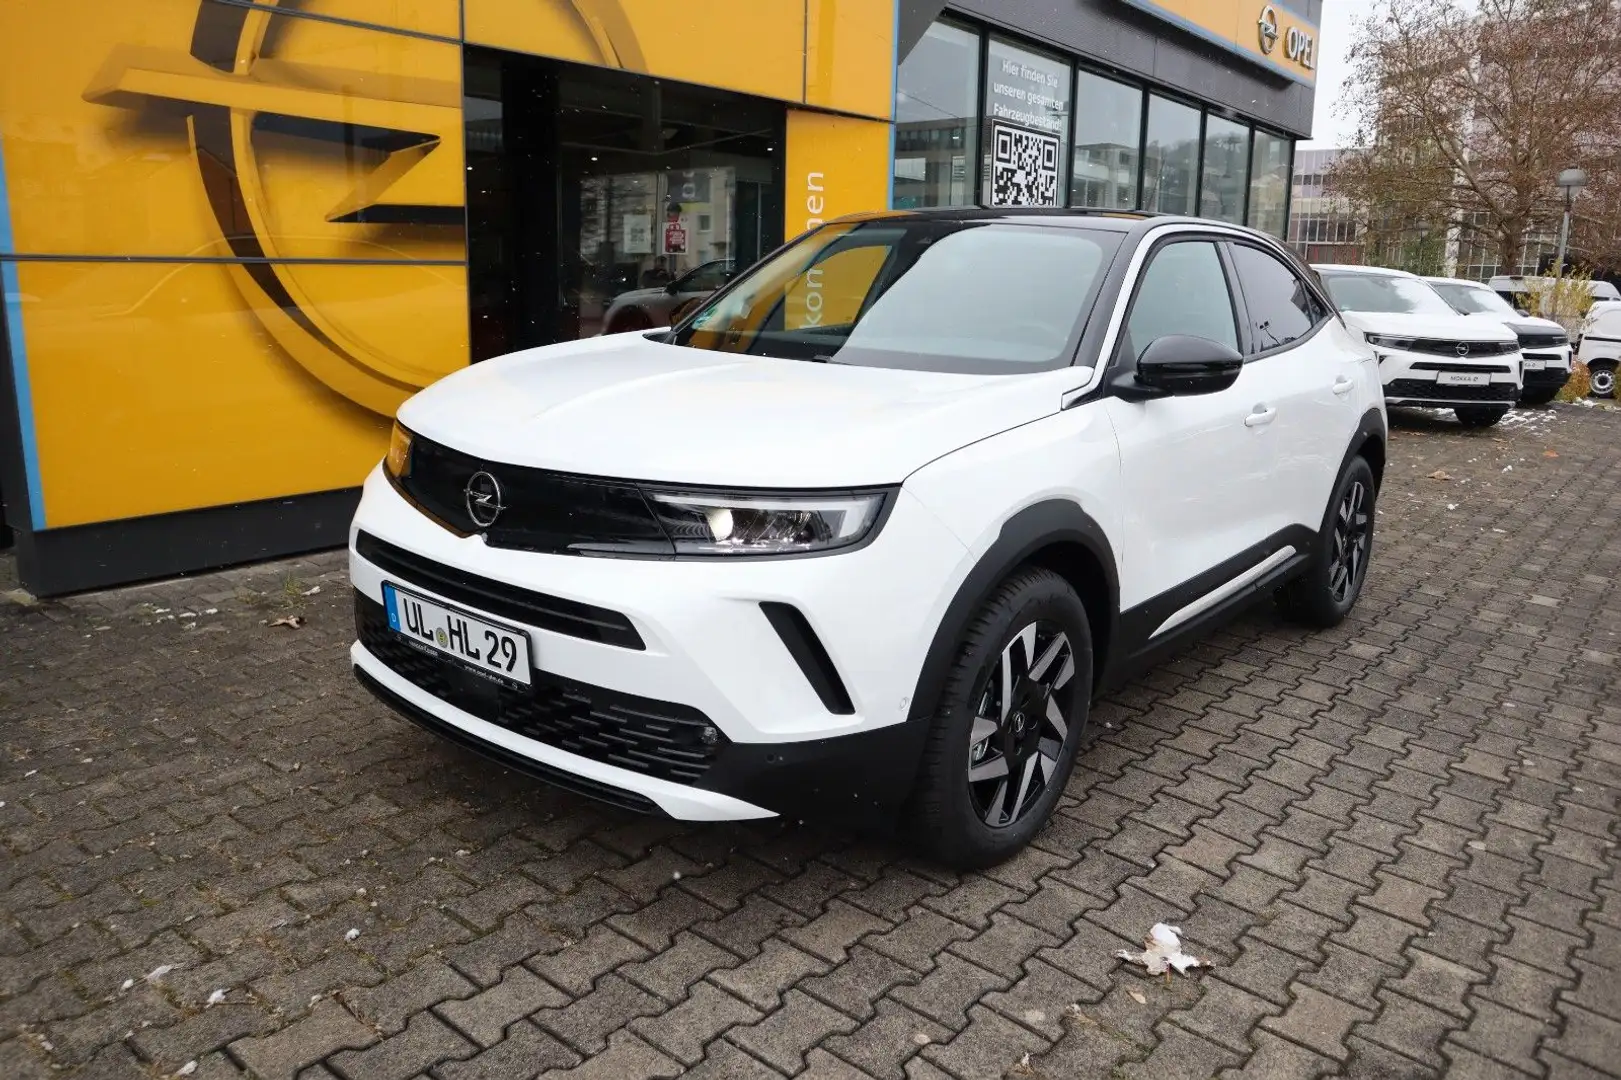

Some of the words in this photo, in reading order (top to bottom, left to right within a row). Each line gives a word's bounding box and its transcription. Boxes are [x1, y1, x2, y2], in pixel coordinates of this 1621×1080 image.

[1285, 27, 1315, 69] OPEL
[1002, 59, 1018, 77] Hier
[1020, 64, 1045, 84] finden
[1047, 74, 1058, 88] Sie
[993, 82, 1026, 101] unseren
[1027, 91, 1064, 111] gesamten
[403, 597, 434, 641] UL
[447, 615, 480, 660] HL
[484, 630, 517, 672] 29
